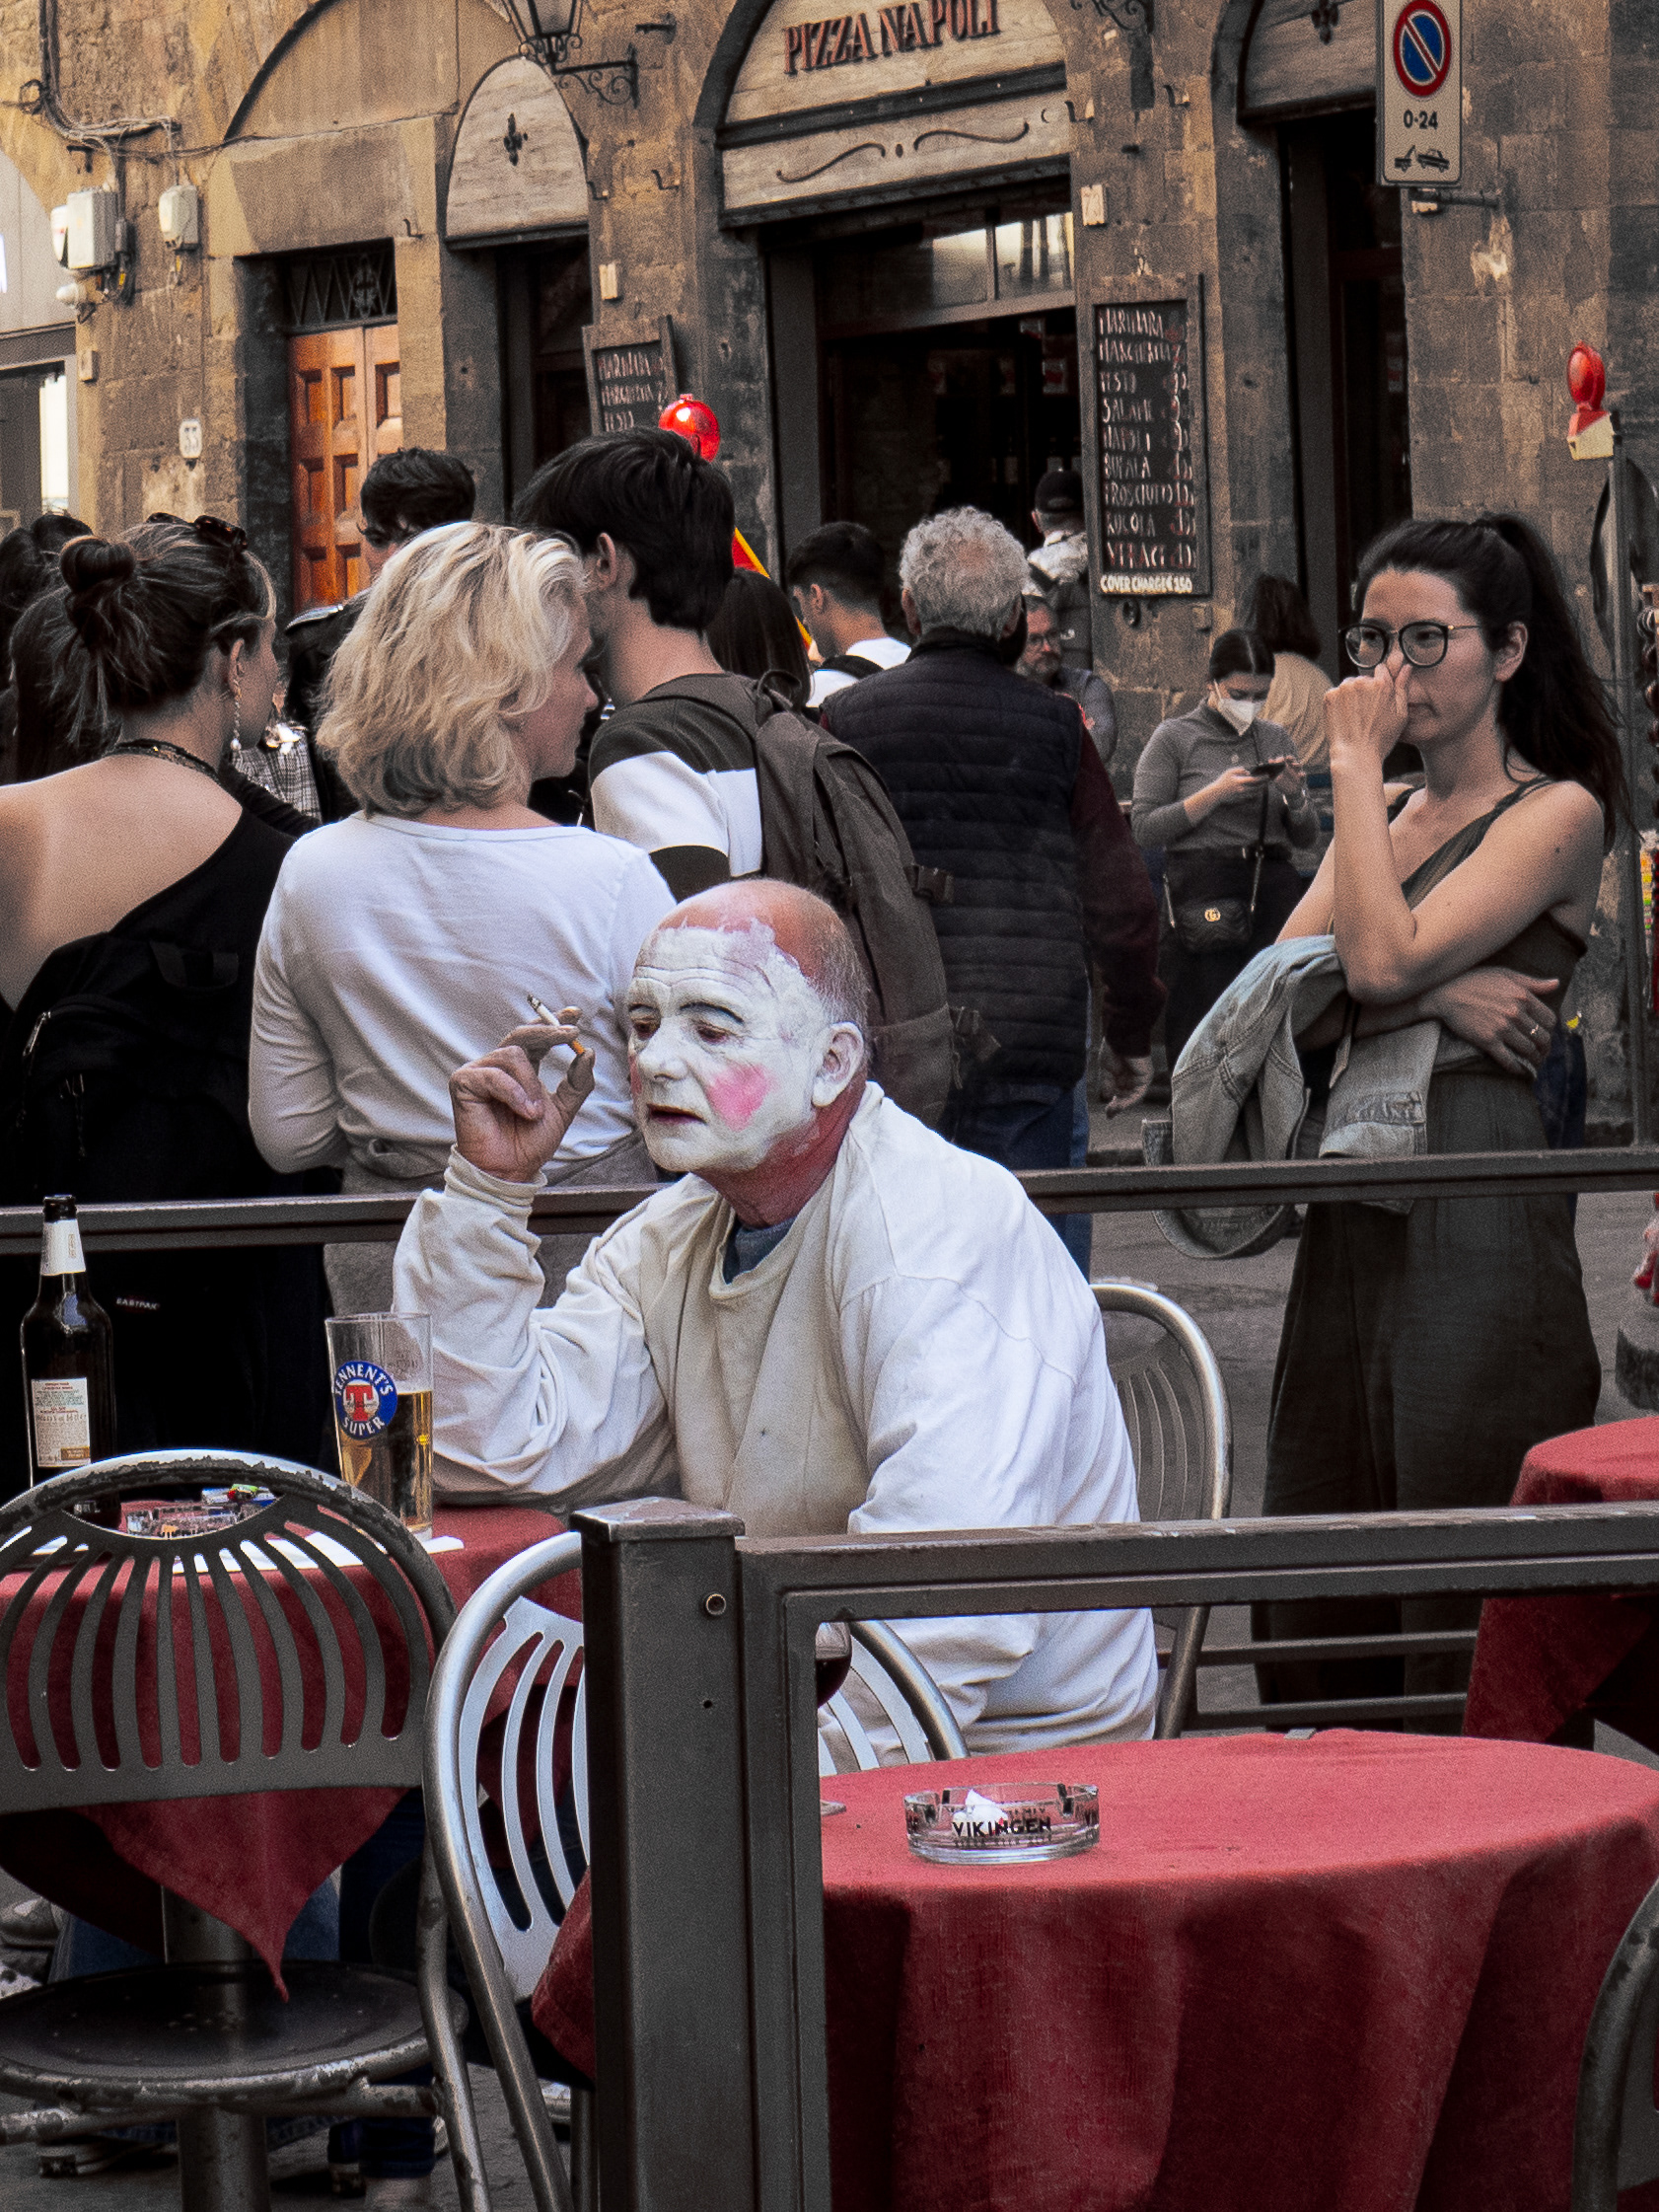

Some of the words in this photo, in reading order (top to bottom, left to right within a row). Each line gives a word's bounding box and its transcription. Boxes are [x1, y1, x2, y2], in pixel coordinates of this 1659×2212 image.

[783, 12, 879, 76] PIZZA
[879, 0, 1000, 56] NAPOLI
[1100, 574, 1131, 593] COVER
[115, 1296, 158, 1310] EASTPAK
[334, 1363, 394, 1396] TENNENT'S
[342, 1416, 385, 1436] SUPER
[952, 1816, 1051, 1837] VIKINGEN
